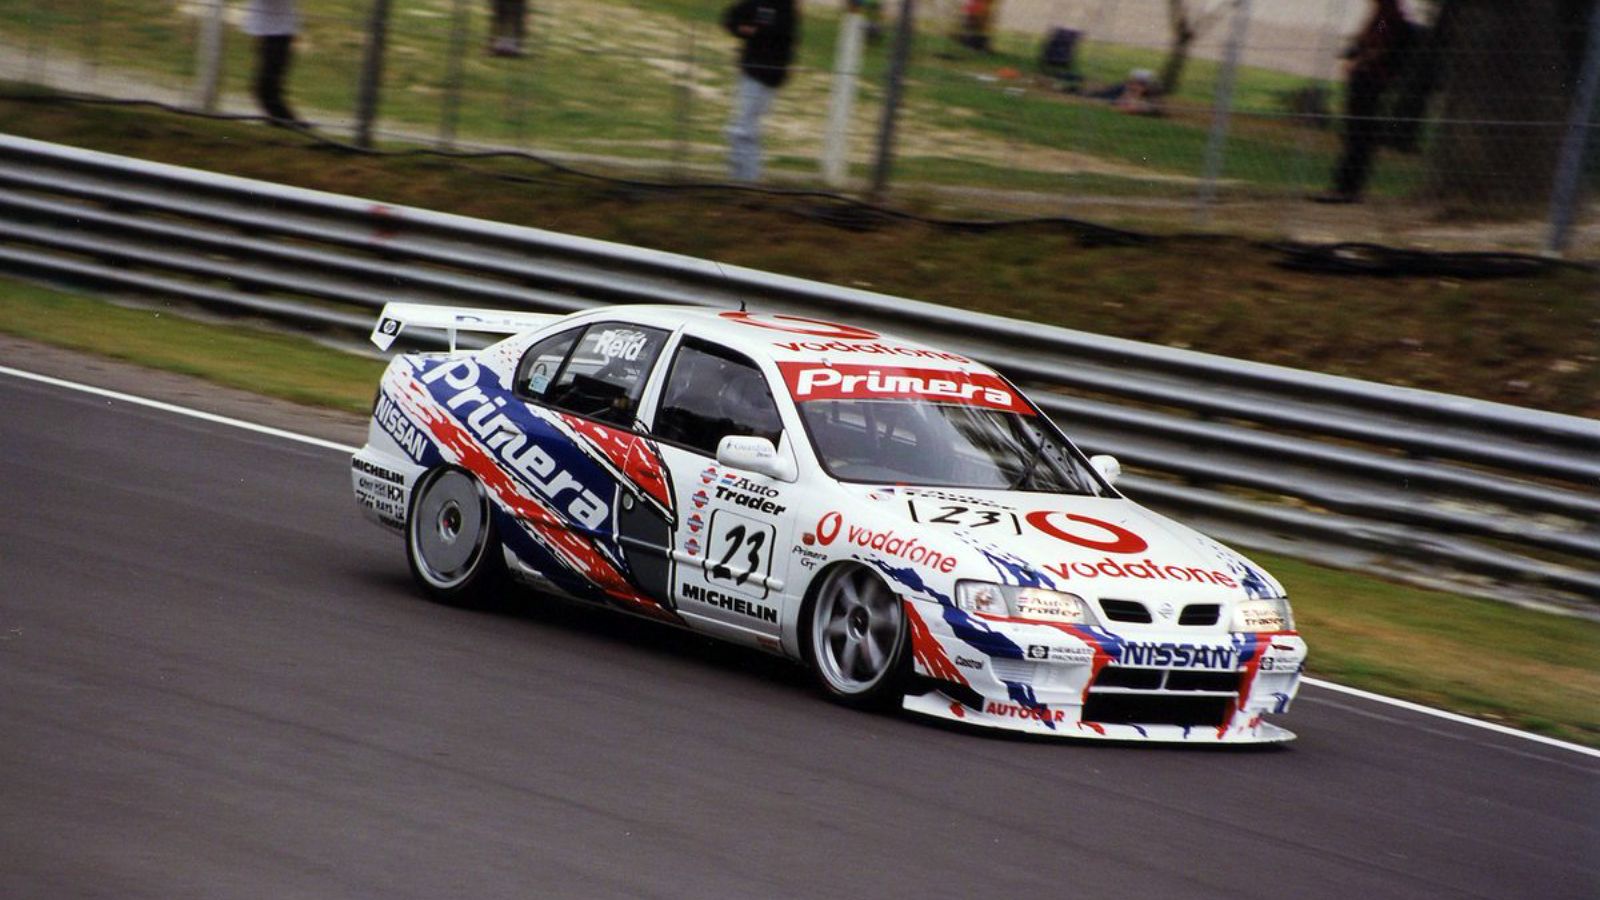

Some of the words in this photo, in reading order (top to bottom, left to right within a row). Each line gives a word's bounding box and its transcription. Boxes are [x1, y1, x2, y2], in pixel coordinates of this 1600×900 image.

[593, 329, 647, 361] Reid
[773, 341, 973, 365] vodafone
[796, 368, 1013, 406] Primera
[374, 396, 429, 462] NISSAN
[420, 356, 610, 531] Primera
[351, 458, 404, 486] MICHELIN
[732, 477, 779, 498] Auto
[715, 486, 786, 516] Trader
[930, 506, 1002, 528] 23
[713, 524, 766, 586] 23
[847, 524, 957, 574] vodafone
[1043, 557, 1240, 590] vodafone
[681, 582, 778, 624] MICHELIN
[1122, 640, 1236, 671] NISSAN
[986, 701, 1066, 723] AUTOCAR
